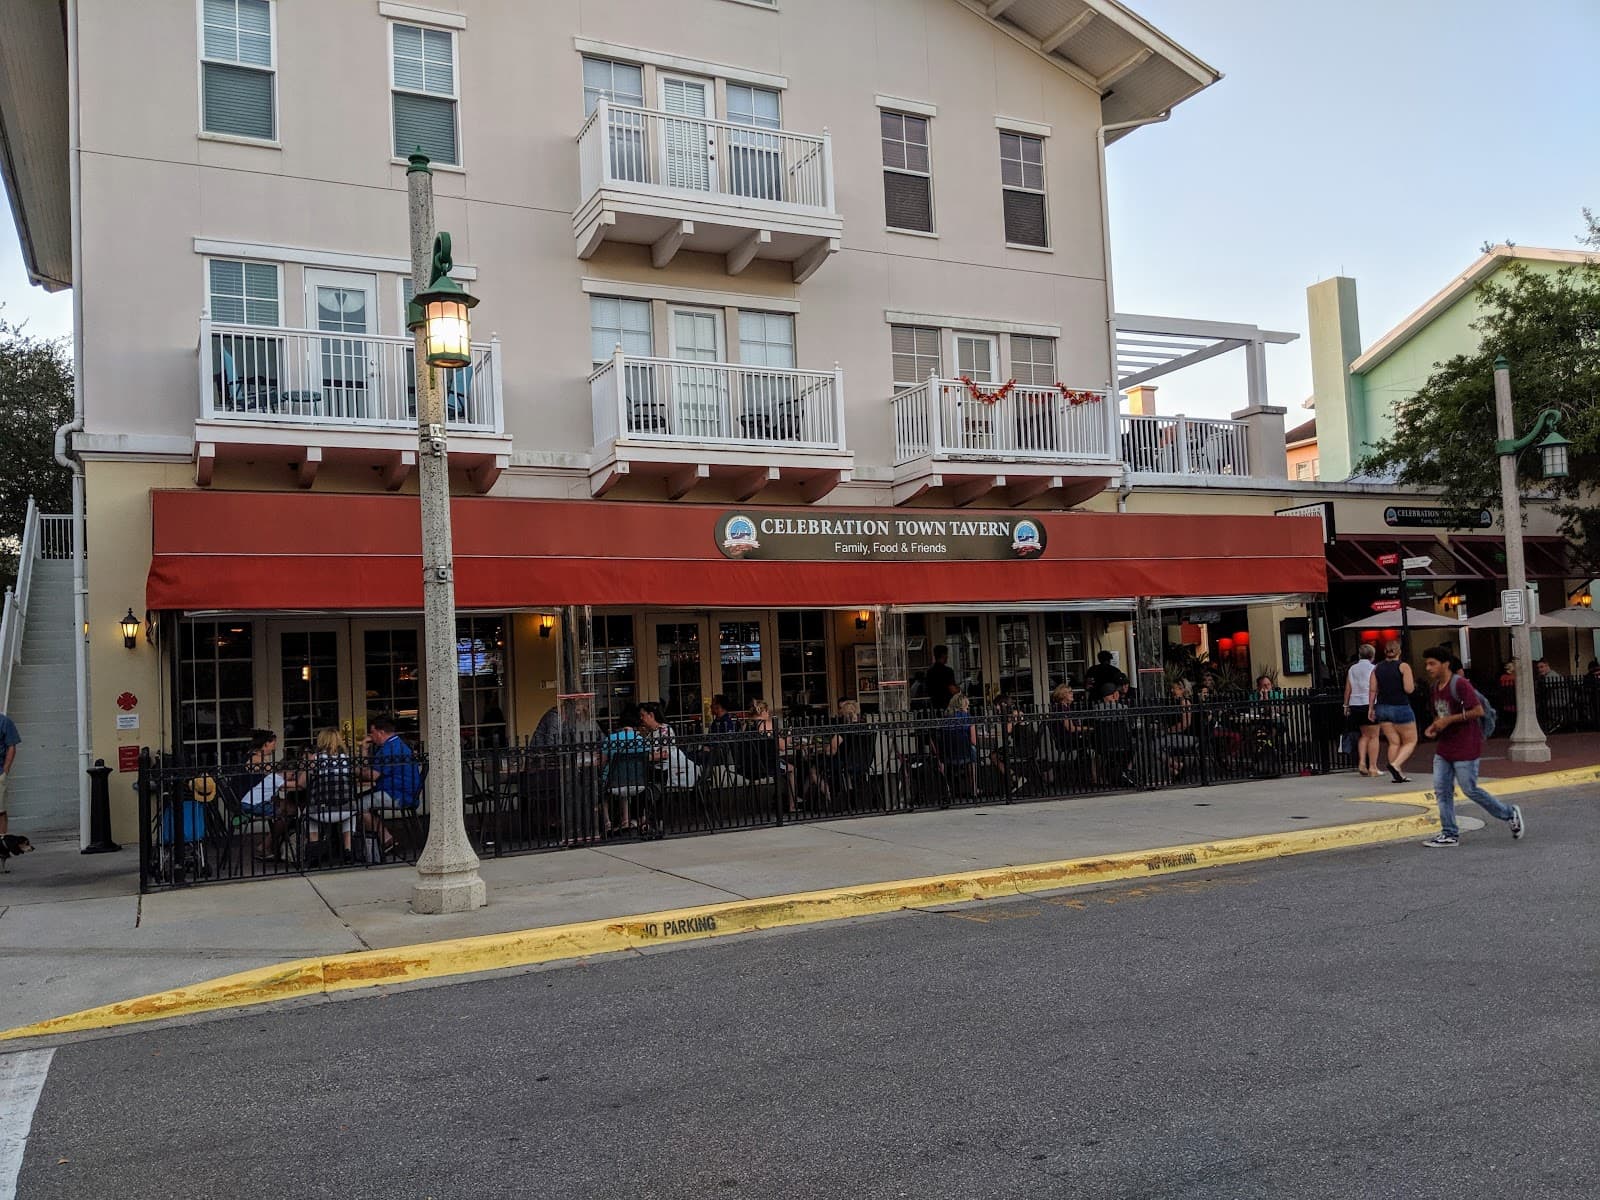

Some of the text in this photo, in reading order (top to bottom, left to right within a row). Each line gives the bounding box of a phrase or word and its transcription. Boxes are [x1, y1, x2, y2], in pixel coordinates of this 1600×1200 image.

[760, 518, 889, 535] CELEBRATION
[895, 520, 946, 536] TOWN
[949, 521, 1010, 536] TAVERN
[834, 541, 947, 555] Family, Food & Friends
[663, 915, 716, 936] PARKING
